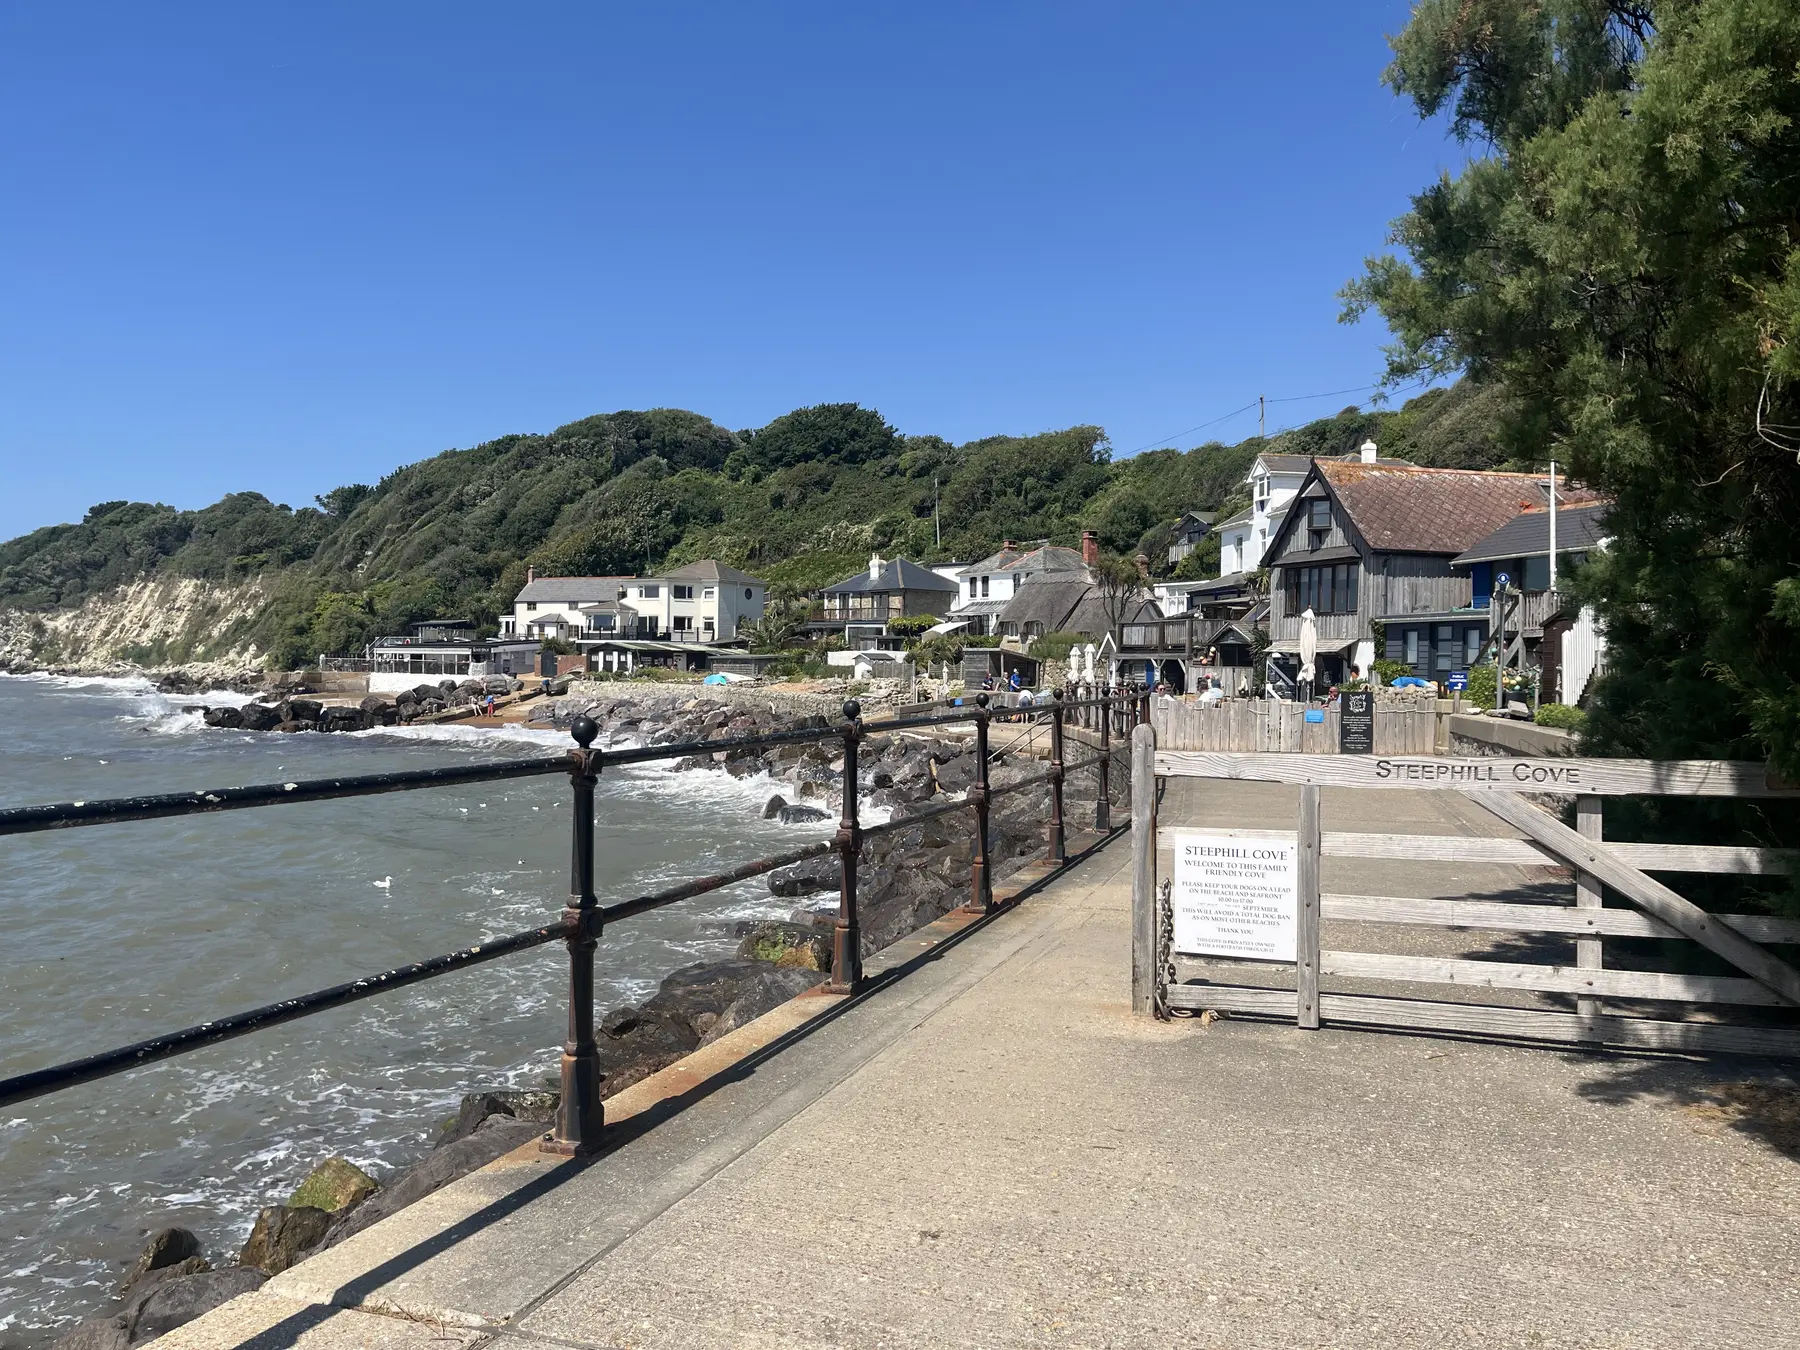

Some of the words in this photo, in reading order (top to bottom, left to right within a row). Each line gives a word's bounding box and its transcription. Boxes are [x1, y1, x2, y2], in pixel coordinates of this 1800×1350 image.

[1186, 846, 1250, 858] STEEPHILL
[1253, 850, 1287, 860] COVE
[1184, 860, 1224, 868] WELCOME
[1205, 869, 1243, 877] FRIENDLY
